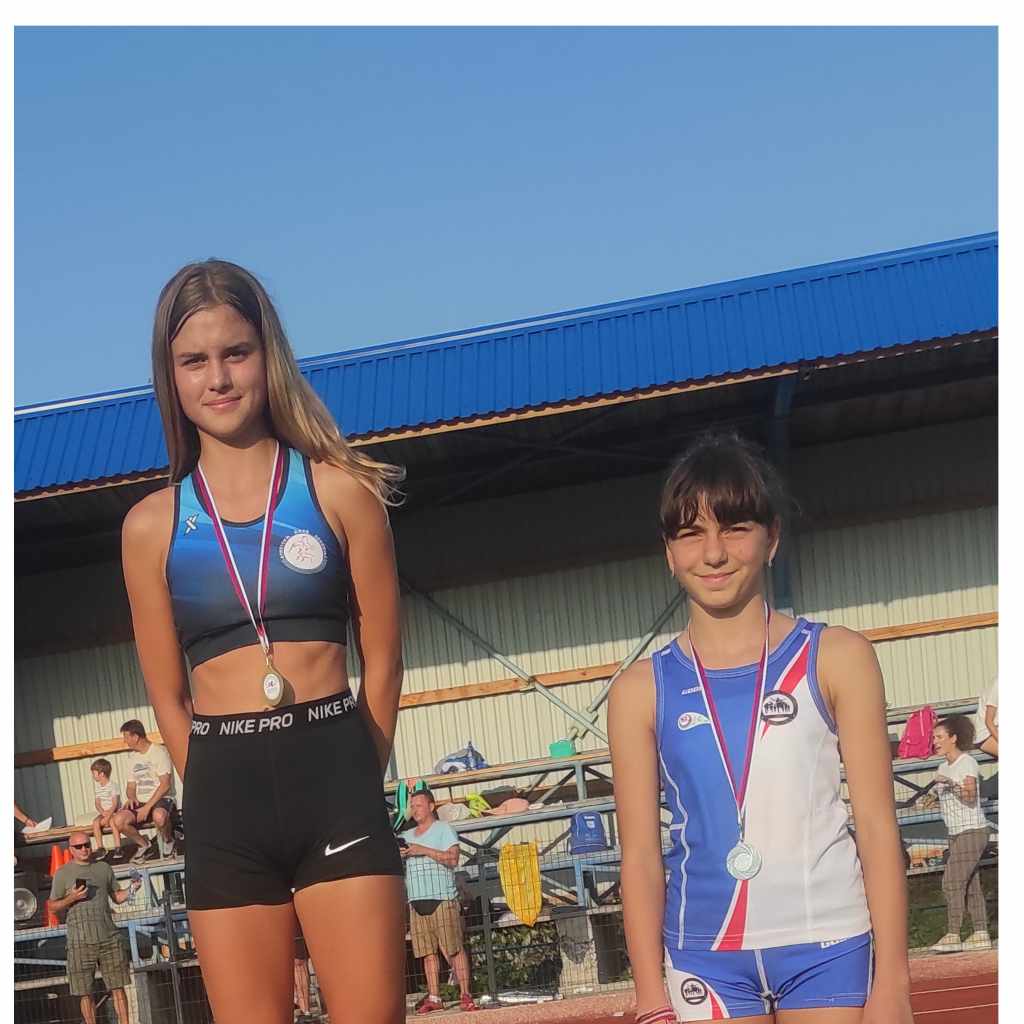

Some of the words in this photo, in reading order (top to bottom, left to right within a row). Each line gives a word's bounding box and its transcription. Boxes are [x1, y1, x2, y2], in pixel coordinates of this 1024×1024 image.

[219, 719, 256, 736] NIKE
[258, 713, 294, 733] PRO
[308, 700, 343, 722] NIKE
[343, 696, 358, 712] PR
